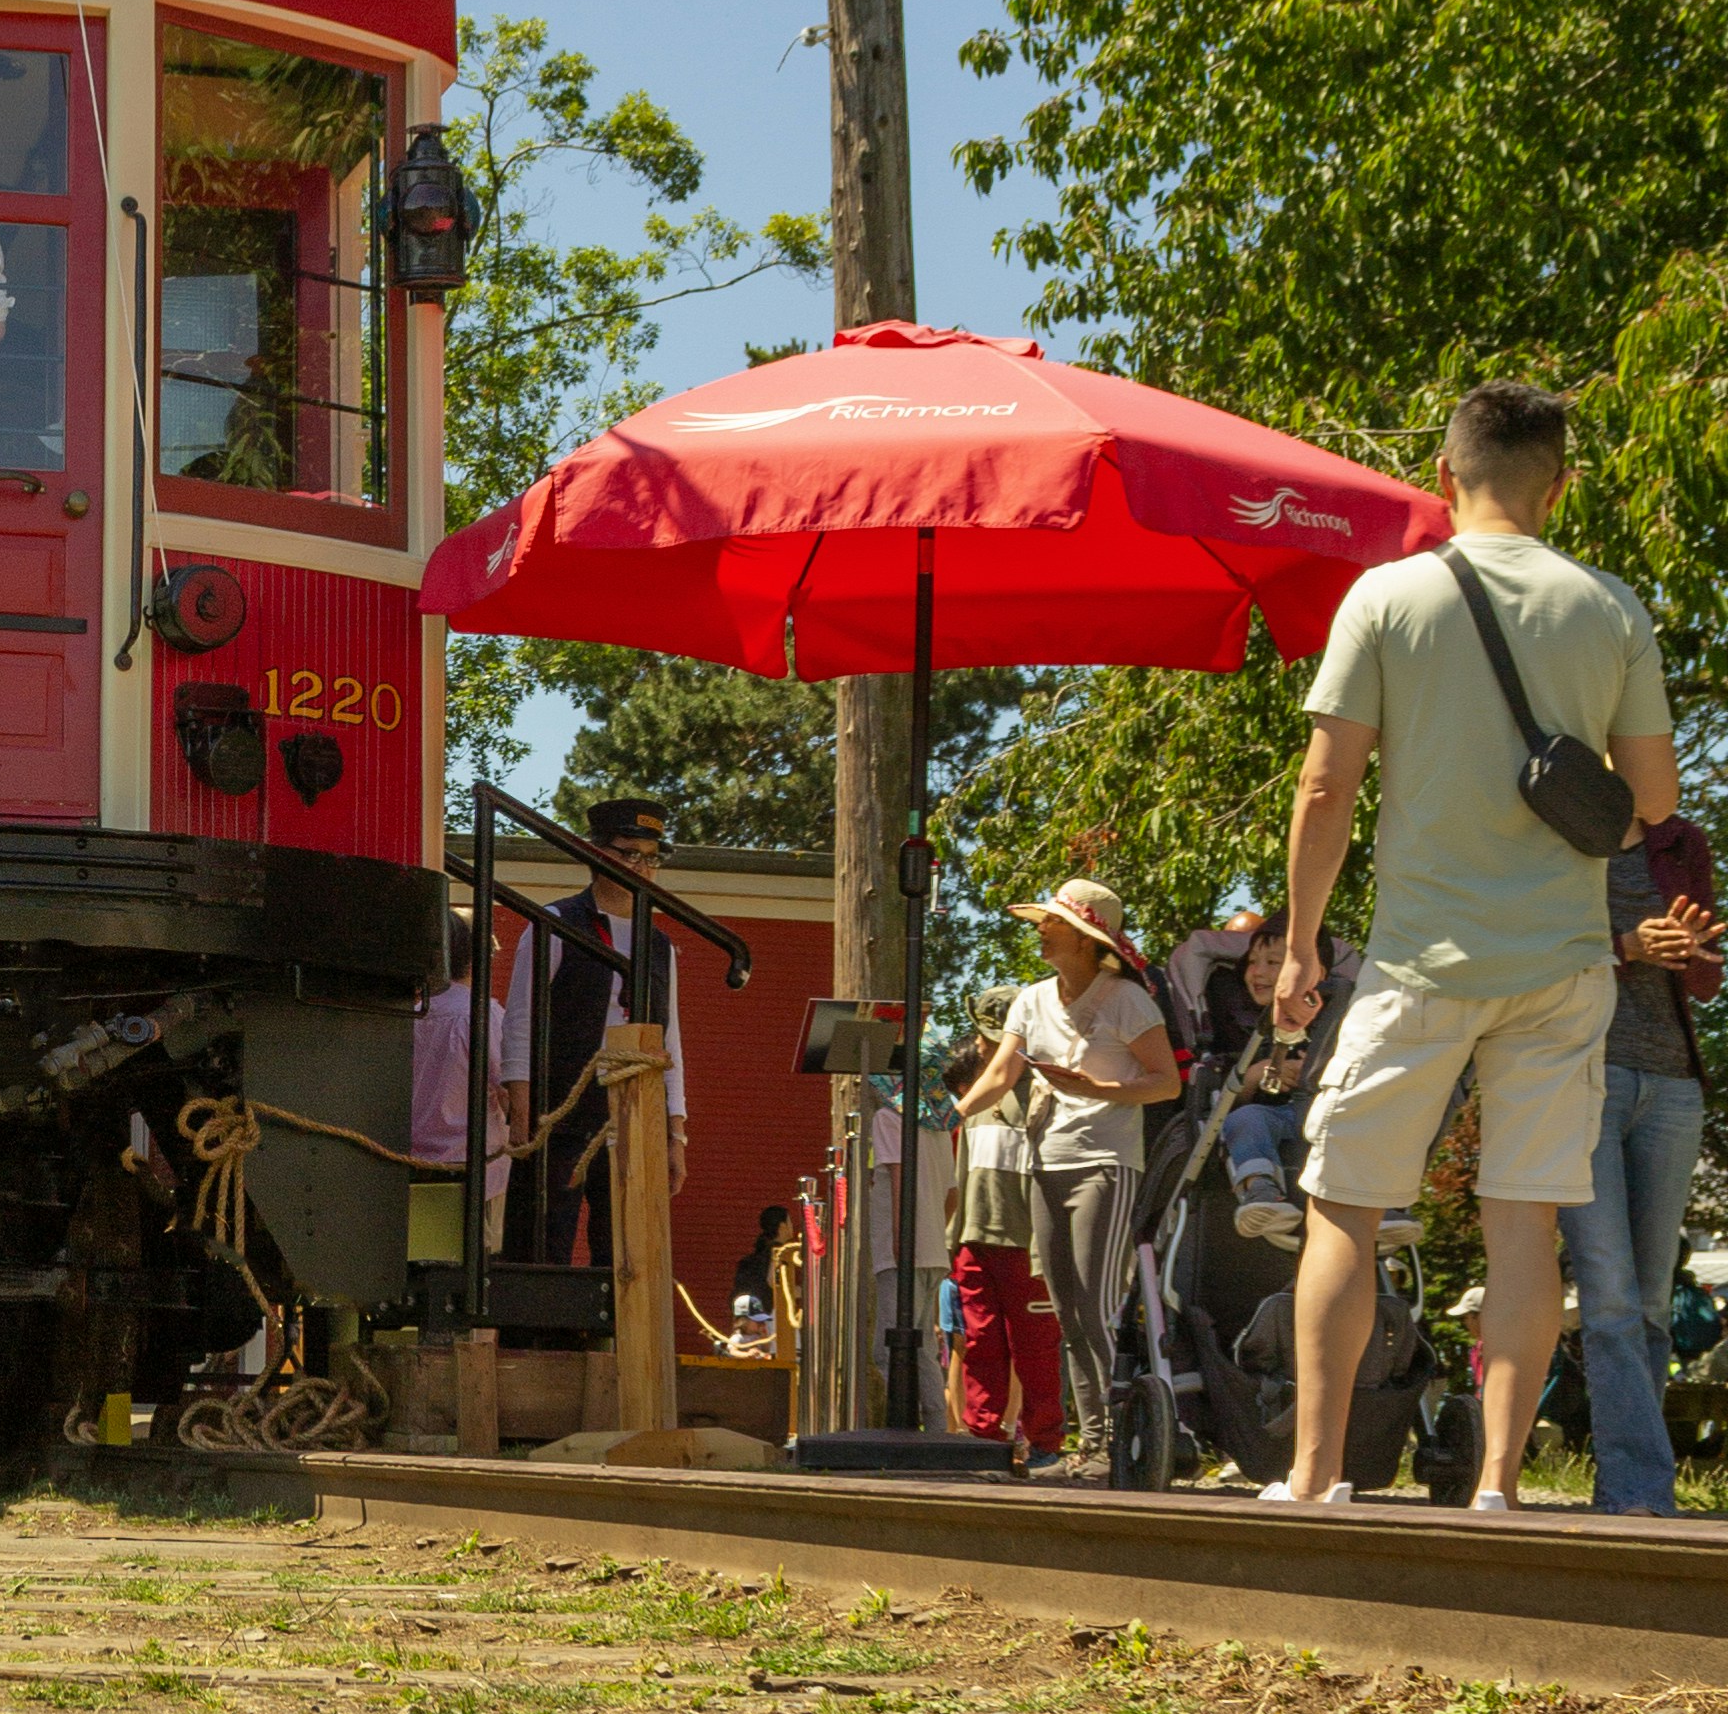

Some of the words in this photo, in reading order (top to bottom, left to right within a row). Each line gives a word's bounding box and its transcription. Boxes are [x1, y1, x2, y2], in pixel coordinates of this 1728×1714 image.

[828, 401, 1018, 420] Richmond
[1284, 504, 1352, 537] Richmond
[263, 668, 403, 732] 1220
